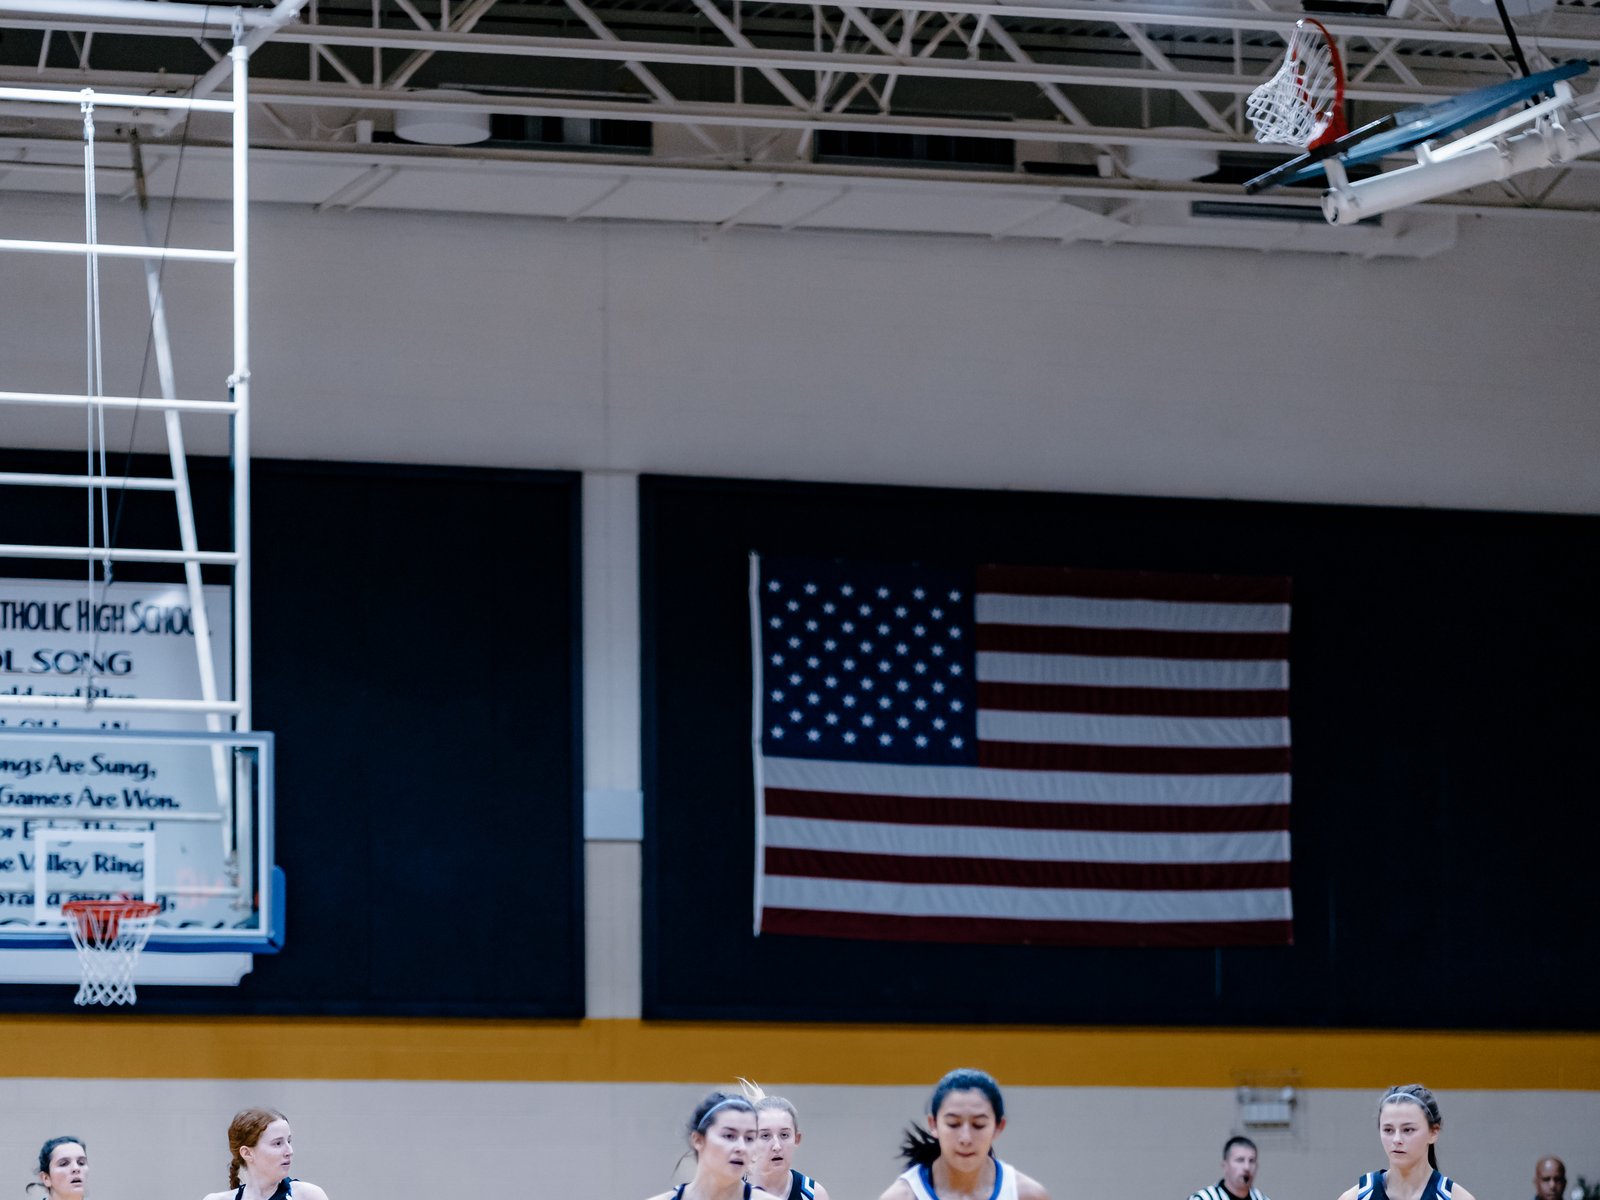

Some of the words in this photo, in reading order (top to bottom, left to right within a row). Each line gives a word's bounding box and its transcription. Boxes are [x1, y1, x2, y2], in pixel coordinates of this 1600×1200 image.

[29, 649, 132, 675] SONG
[47, 753, 85, 775] Are
[90, 753, 157, 781] Sung,
[77, 786, 119, 808] Are
[123, 789, 180, 810] Won.
[18, 852, 88, 880] Vlley
